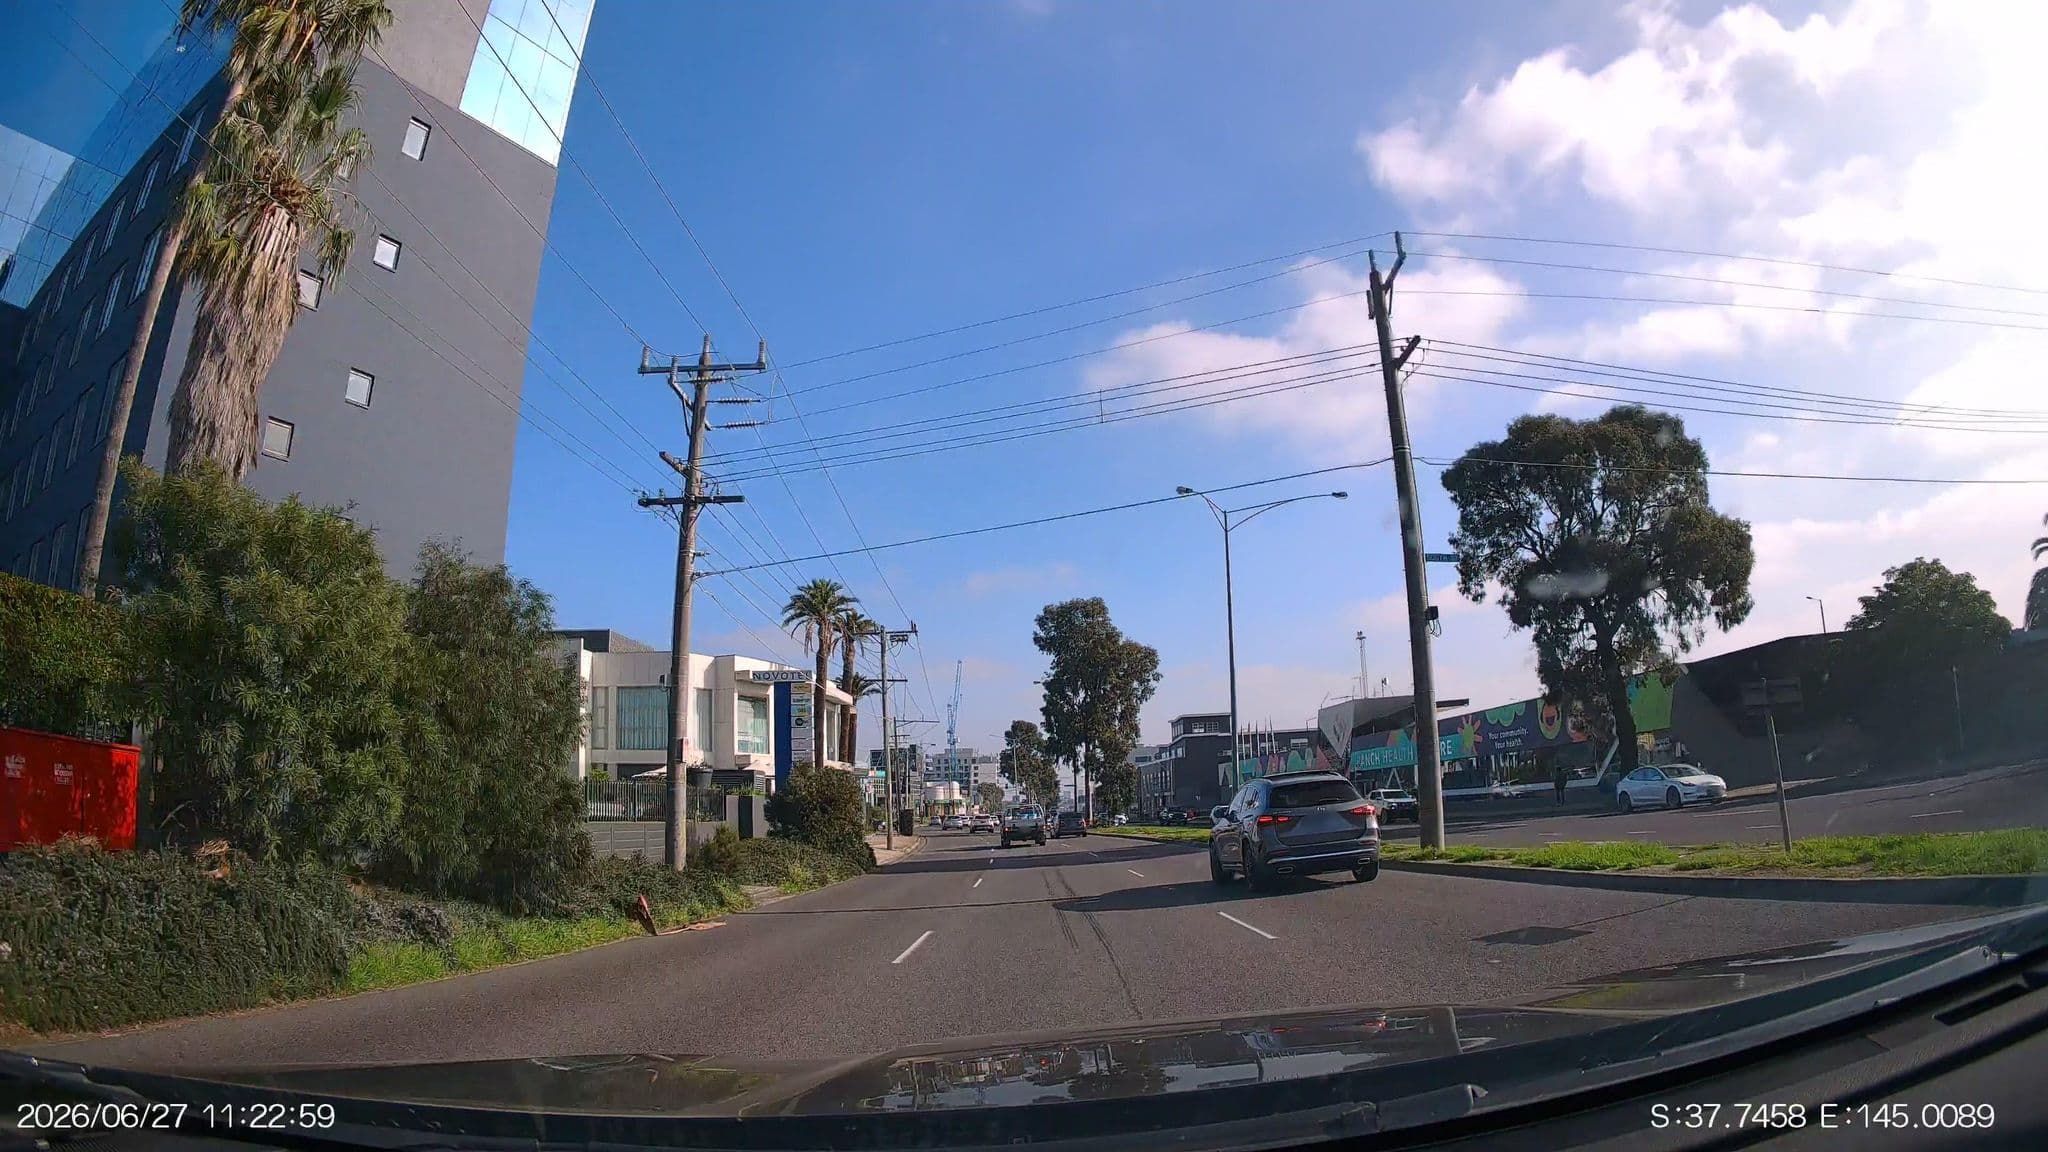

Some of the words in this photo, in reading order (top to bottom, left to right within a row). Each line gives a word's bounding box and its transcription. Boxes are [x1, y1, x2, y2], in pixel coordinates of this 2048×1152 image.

[752, 671, 811, 681] NOVOTEL
[1487, 731, 1499, 740] Your
[1494, 740, 1505, 749] Your
[1382, 745, 1414, 762] HEALTH
